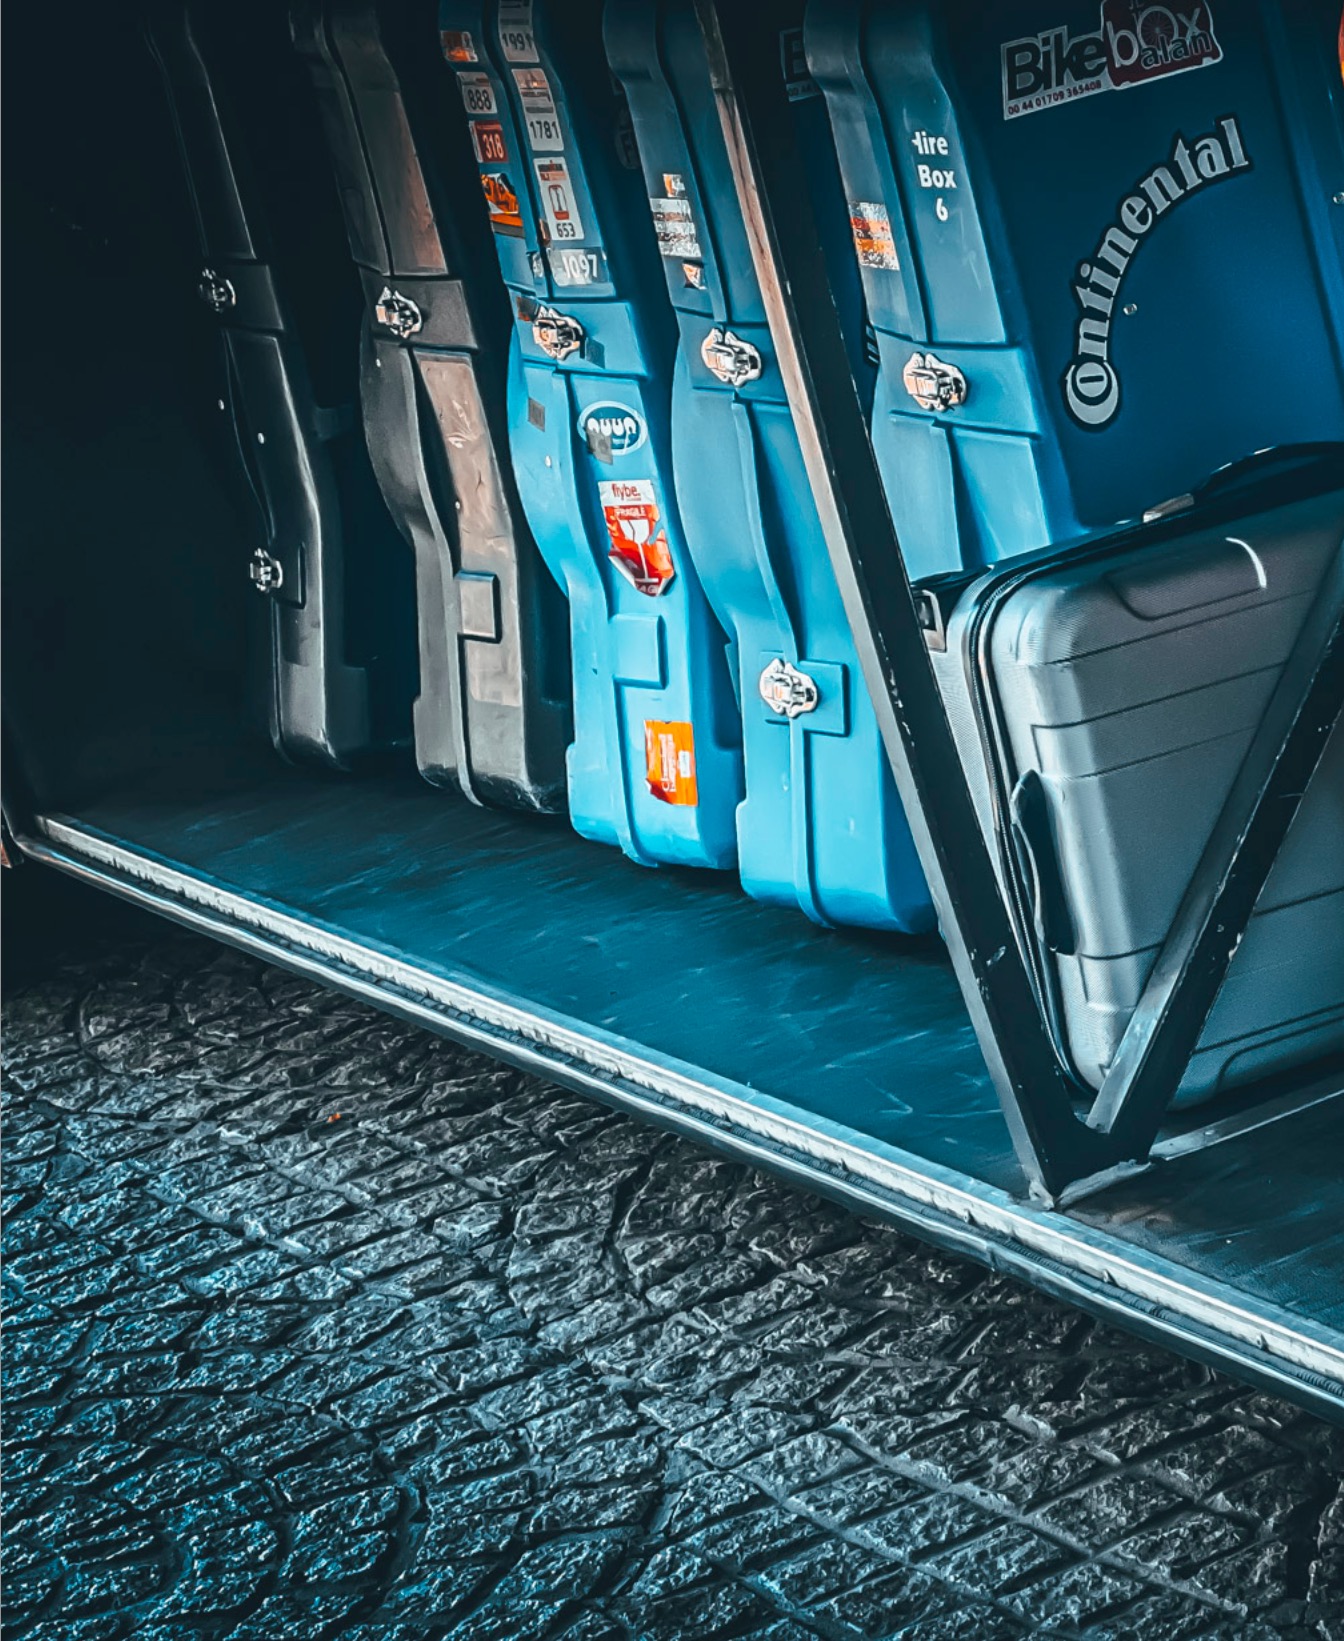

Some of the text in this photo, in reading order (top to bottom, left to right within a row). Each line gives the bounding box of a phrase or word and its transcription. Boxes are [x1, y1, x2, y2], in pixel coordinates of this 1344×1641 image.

[1141, 30, 1212, 70] alan
[467, 88, 492, 110] 888
[529, 120, 560, 139] 1781
[482, 133, 505, 159] 318
[917, 164, 957, 189] Box
[935, 197, 949, 222] 6
[556, 222, 577, 238] 653
[1065, 118, 1249, 425] Continental
